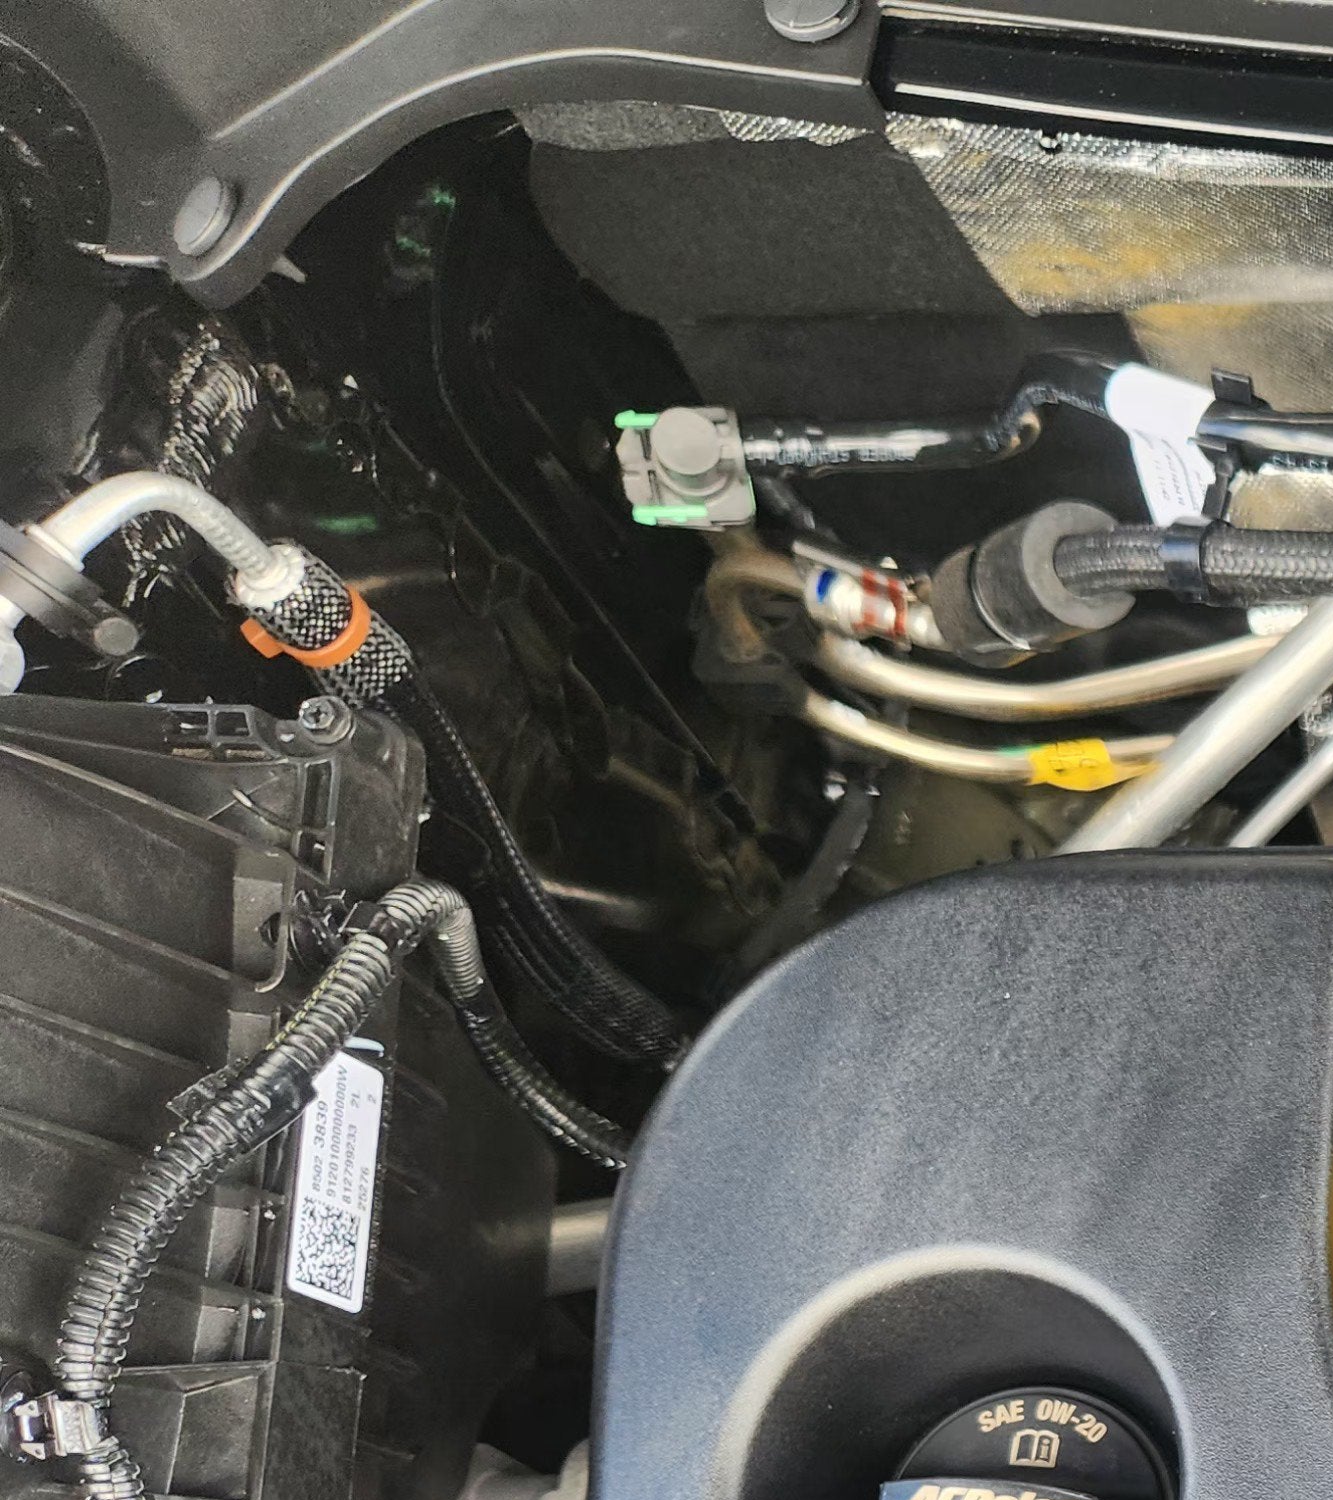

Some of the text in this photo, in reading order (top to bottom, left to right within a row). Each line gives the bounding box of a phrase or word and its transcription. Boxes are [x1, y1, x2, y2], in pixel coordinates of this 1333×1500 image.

[311, 1100, 328, 1193] 8502 3839
[978, 1399, 1109, 1444] SAE 0W-20
